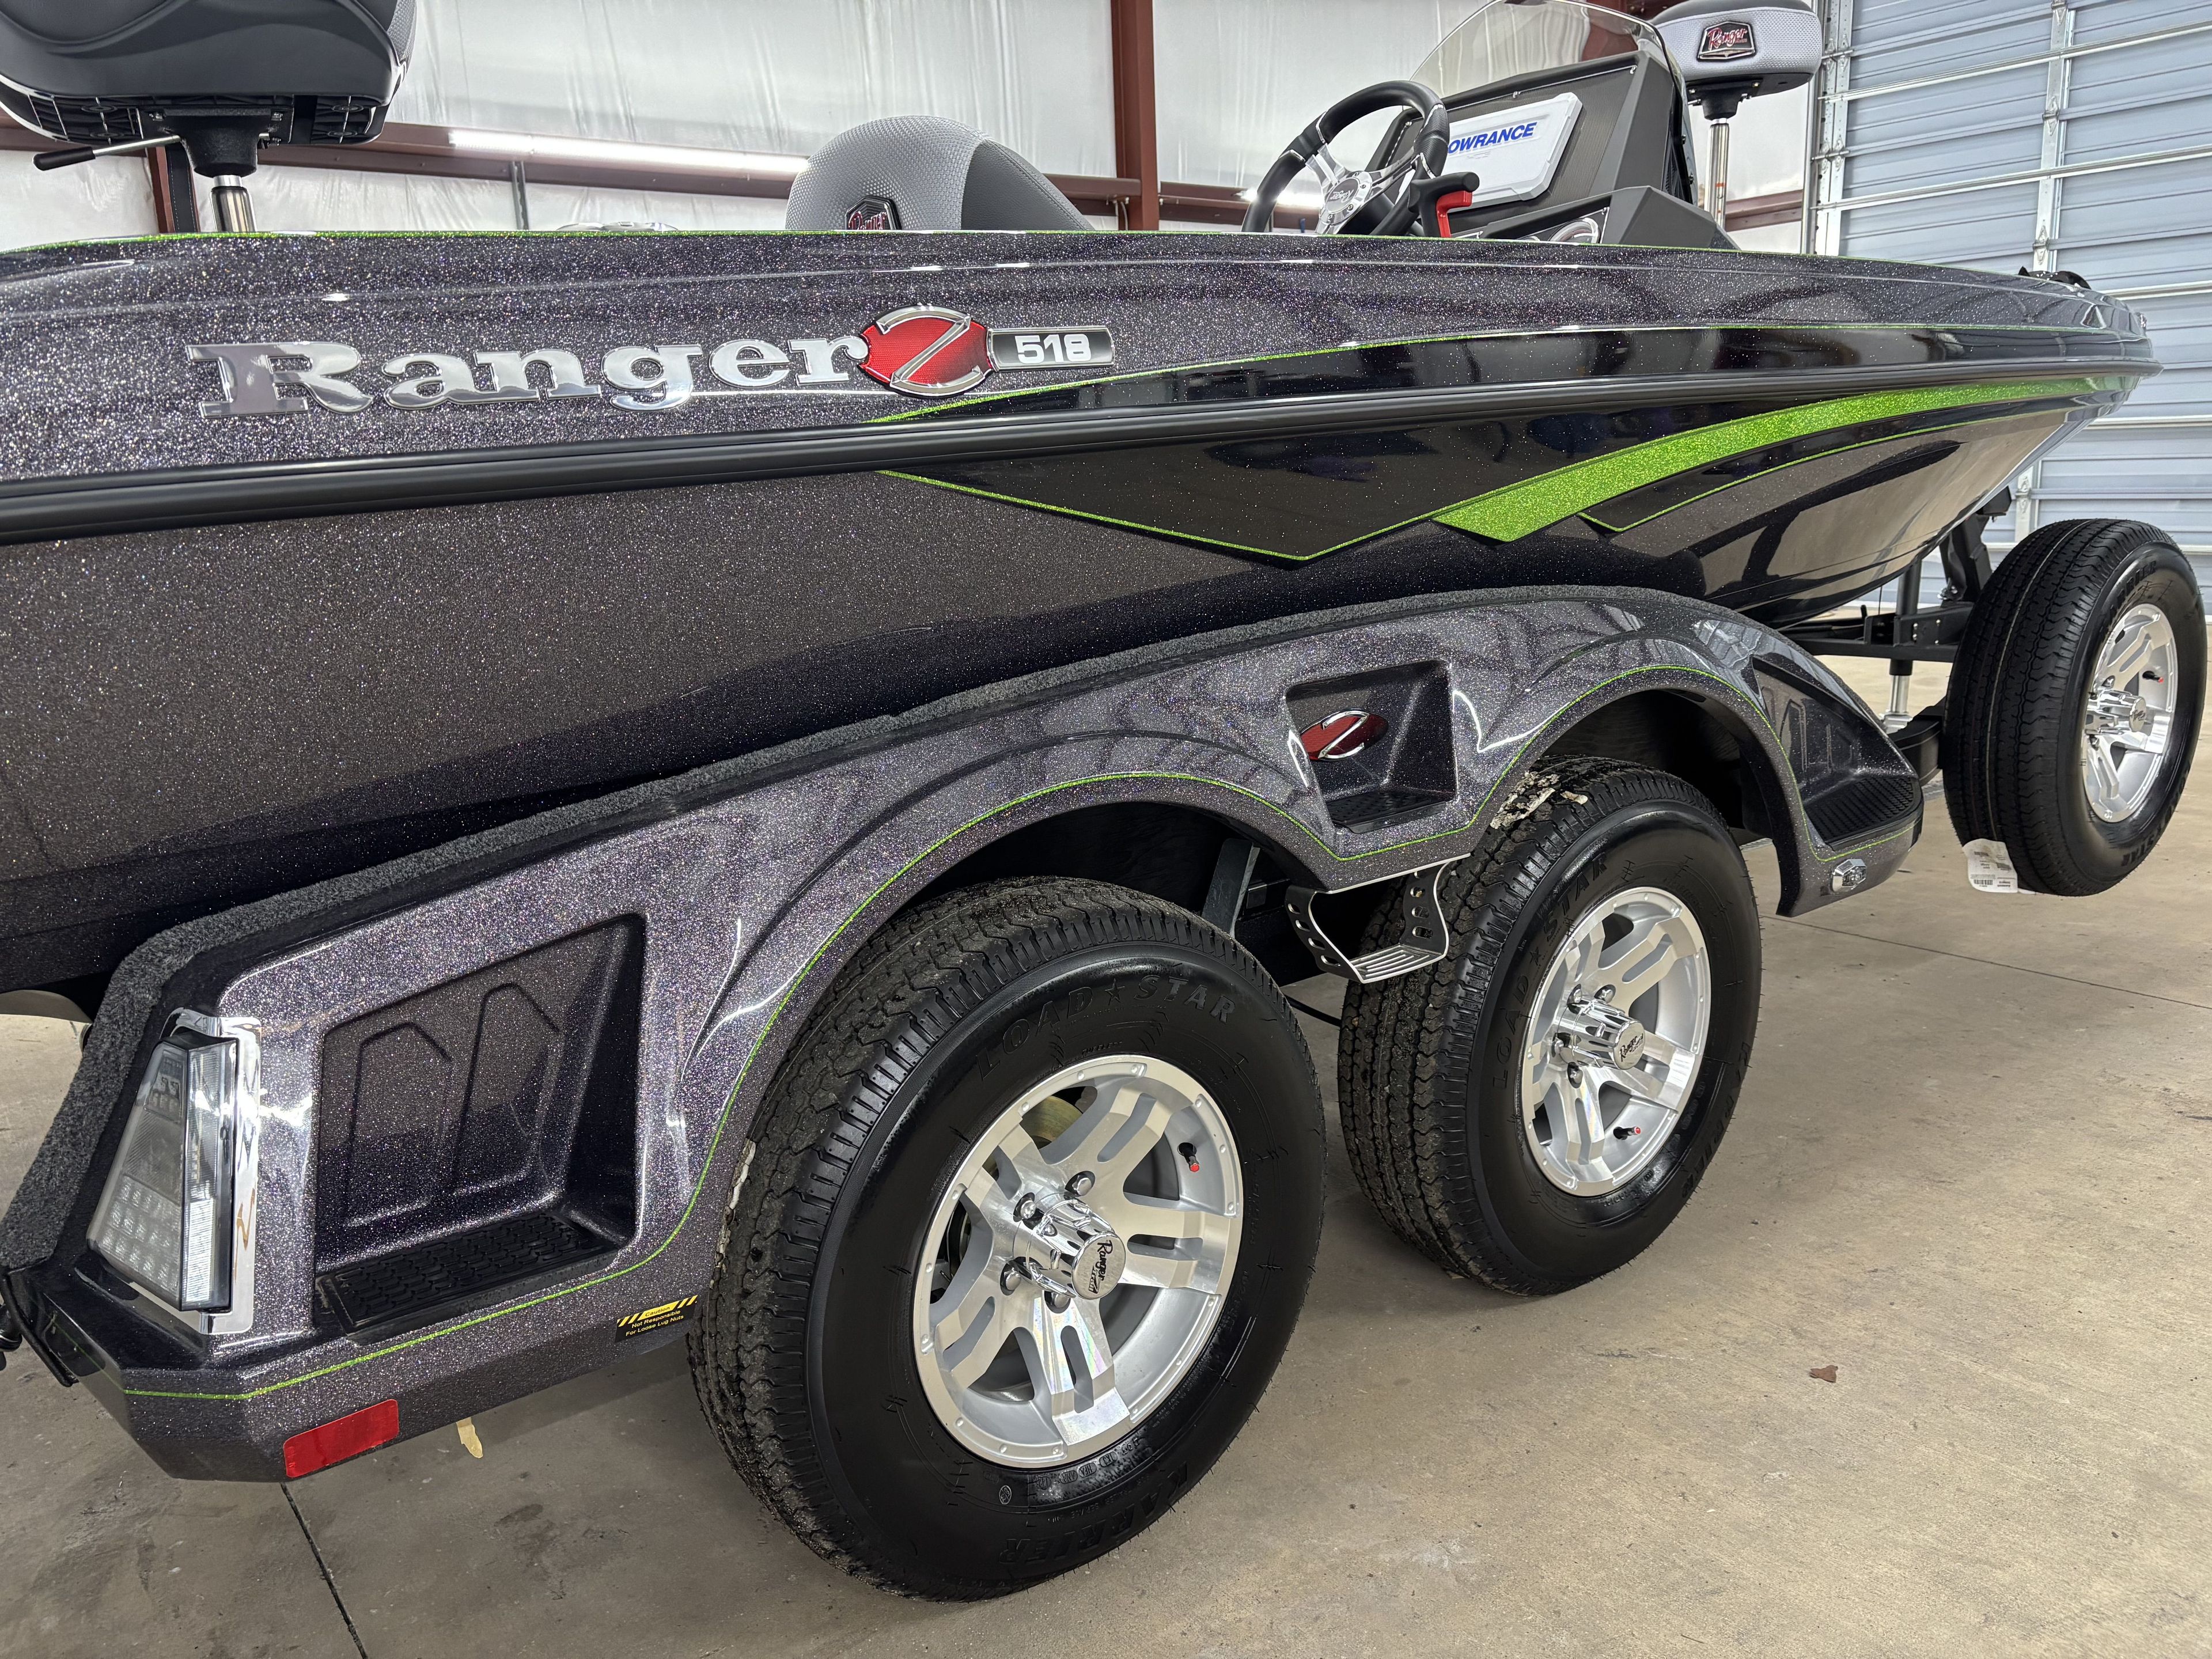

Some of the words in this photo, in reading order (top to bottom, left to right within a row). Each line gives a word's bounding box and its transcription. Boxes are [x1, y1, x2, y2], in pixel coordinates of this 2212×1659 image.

[1707, 27, 1748, 51] Ranger
[1448, 122, 1537, 154] OWRANCE
[185, 336, 870, 419] Ranger
[1014, 333, 1092, 364] 518
[976, 986, 1094, 1081] LOAD
[1133, 975, 1237, 1024] STAR
[1096, 1240, 1113, 1281] Ranger
[638, 1323, 656, 1333] Loose
[670, 1315, 684, 1323] Nuts
[643, 1310, 681, 1324] Responsible
[645, 1306, 671, 1317] Caution
[999, 1461, 1188, 1565] KARRIER
